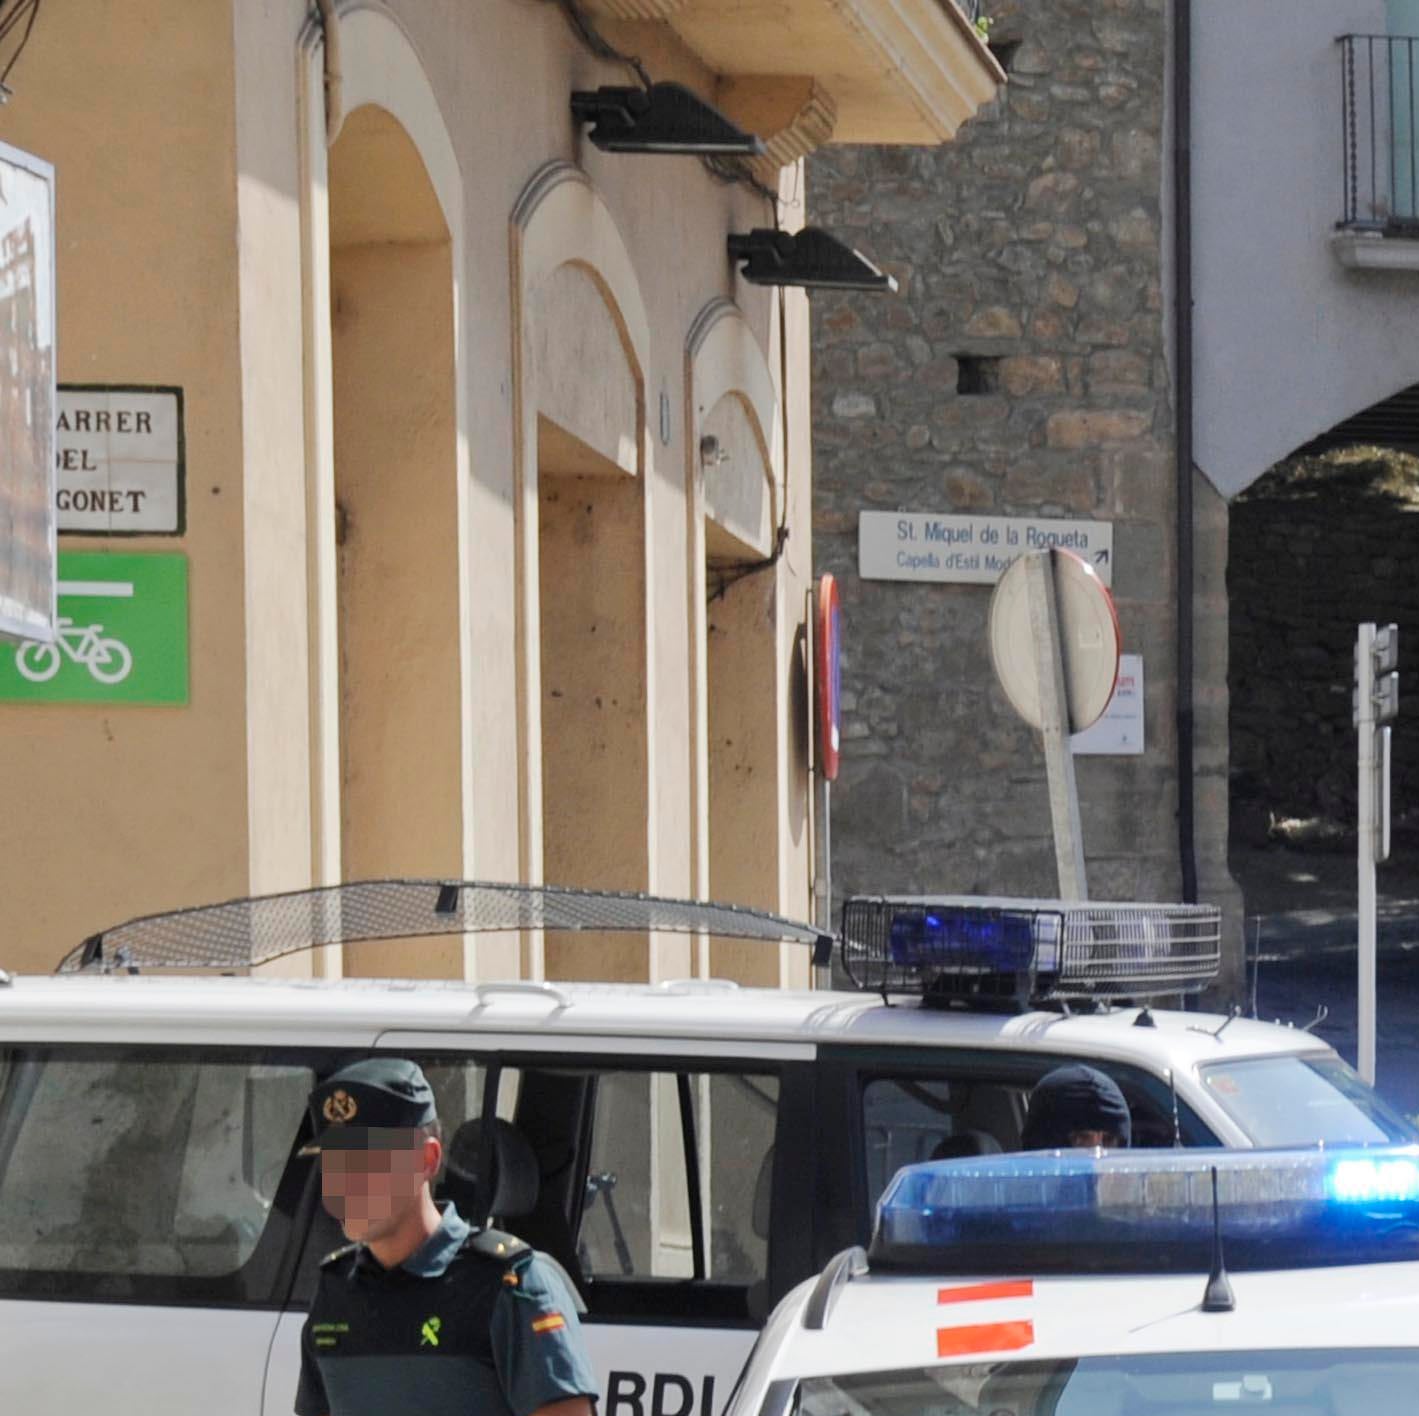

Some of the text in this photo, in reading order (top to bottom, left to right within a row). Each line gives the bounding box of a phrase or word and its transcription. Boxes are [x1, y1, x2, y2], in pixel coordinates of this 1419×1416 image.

[57, 410, 153, 434] ARRER
[56, 448, 97, 471] EL
[57, 489, 147, 514] GONET
[897, 519, 916, 542] St.
[924, 521, 973, 546] Miquel
[979, 524, 999, 546] de
[1006, 526, 1019, 547] la
[984, 554, 1016, 573] Mod
